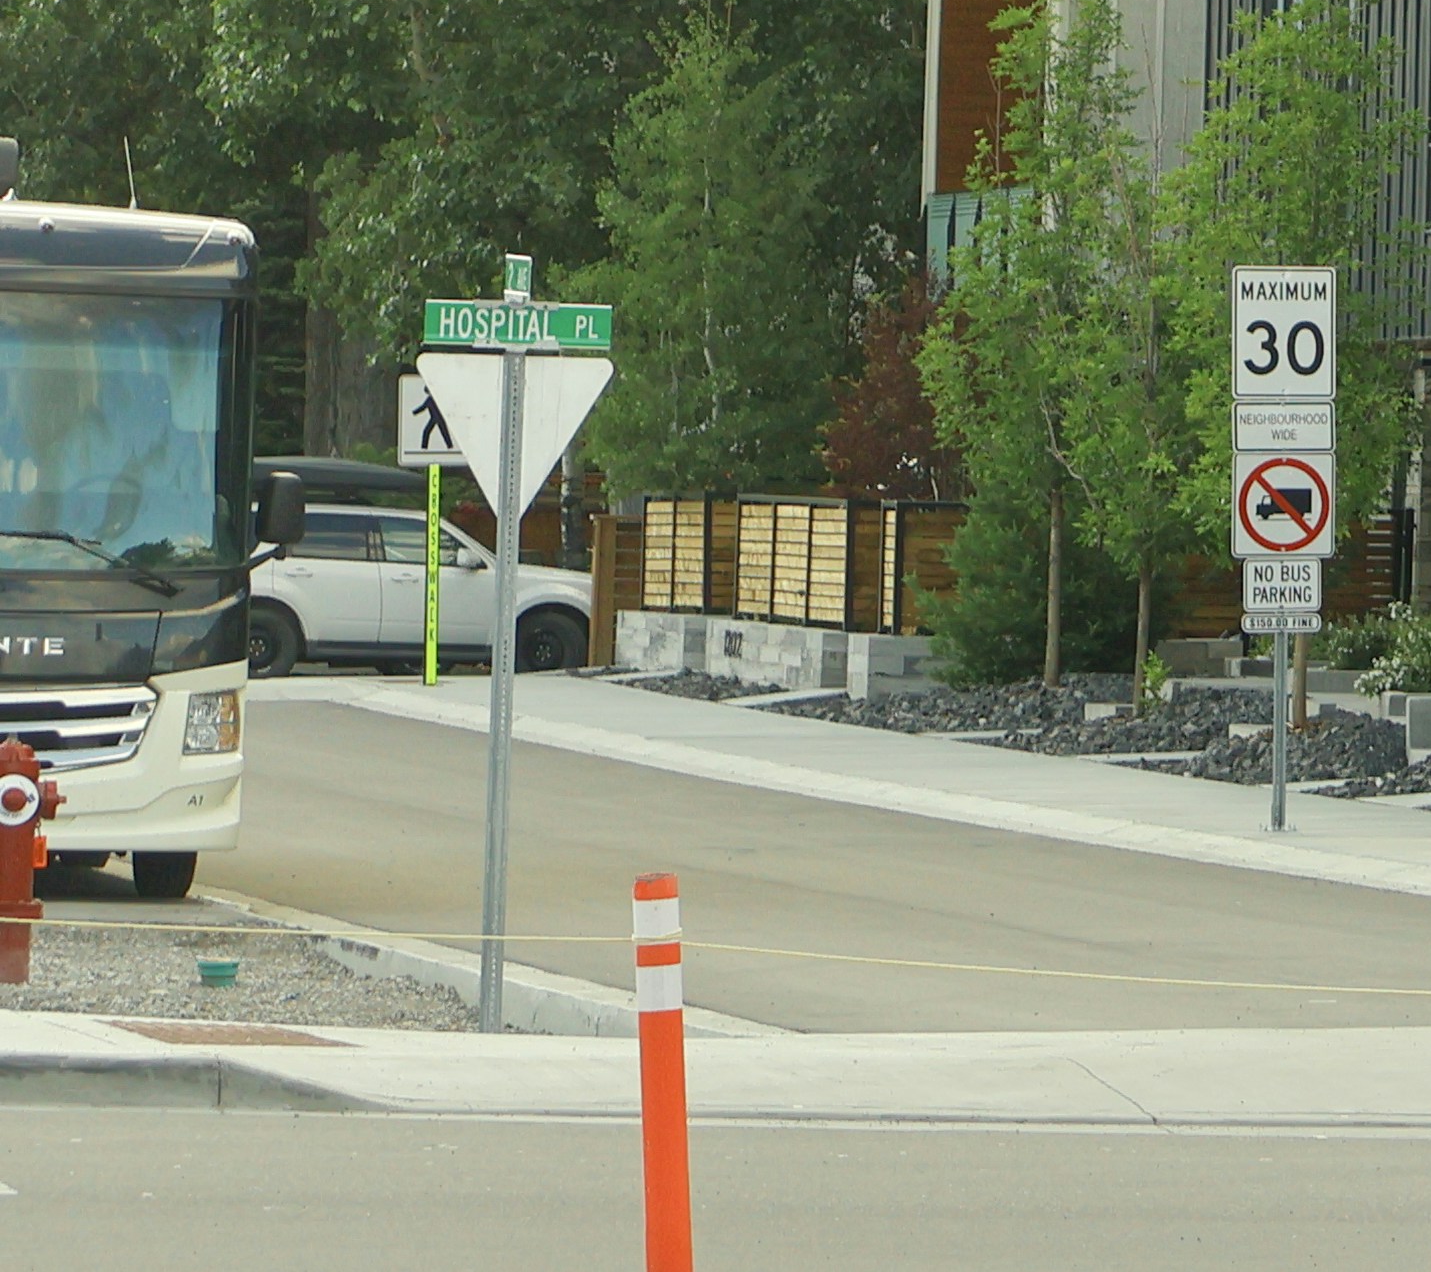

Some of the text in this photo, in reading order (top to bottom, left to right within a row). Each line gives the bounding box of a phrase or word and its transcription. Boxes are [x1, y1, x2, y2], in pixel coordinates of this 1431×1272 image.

[1240, 281, 1327, 301] MAXIMUM
[439, 306, 599, 341] HOSPITAL PL
[1243, 319, 1325, 376] 30
[1239, 412, 1328, 426] NEIGHBOURHOOD
[1271, 428, 1298, 441] WIDE
[1254, 564, 1311, 583] NO BUS
[1253, 585, 1313, 604] PARKING
[1293, 617, 1313, 627] FINE
